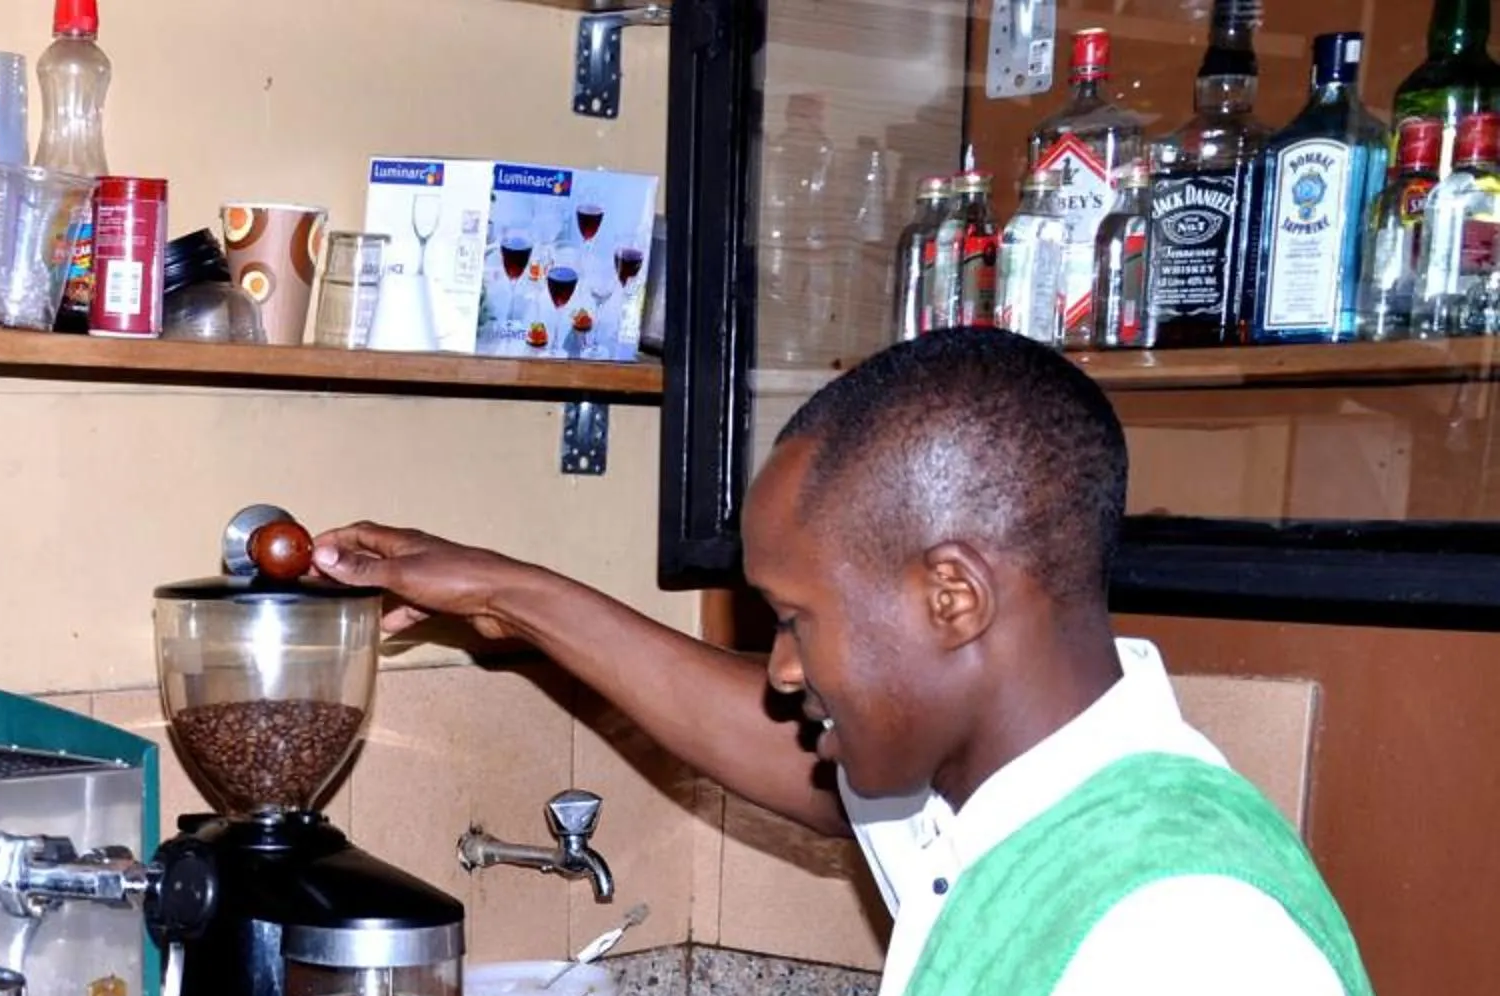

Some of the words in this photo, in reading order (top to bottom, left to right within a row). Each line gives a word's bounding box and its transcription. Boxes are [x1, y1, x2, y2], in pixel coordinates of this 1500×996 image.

[374, 164, 425, 179] Luminarc
[499, 171, 553, 188] Luminarc
[1152, 192, 1184, 219] JACK
